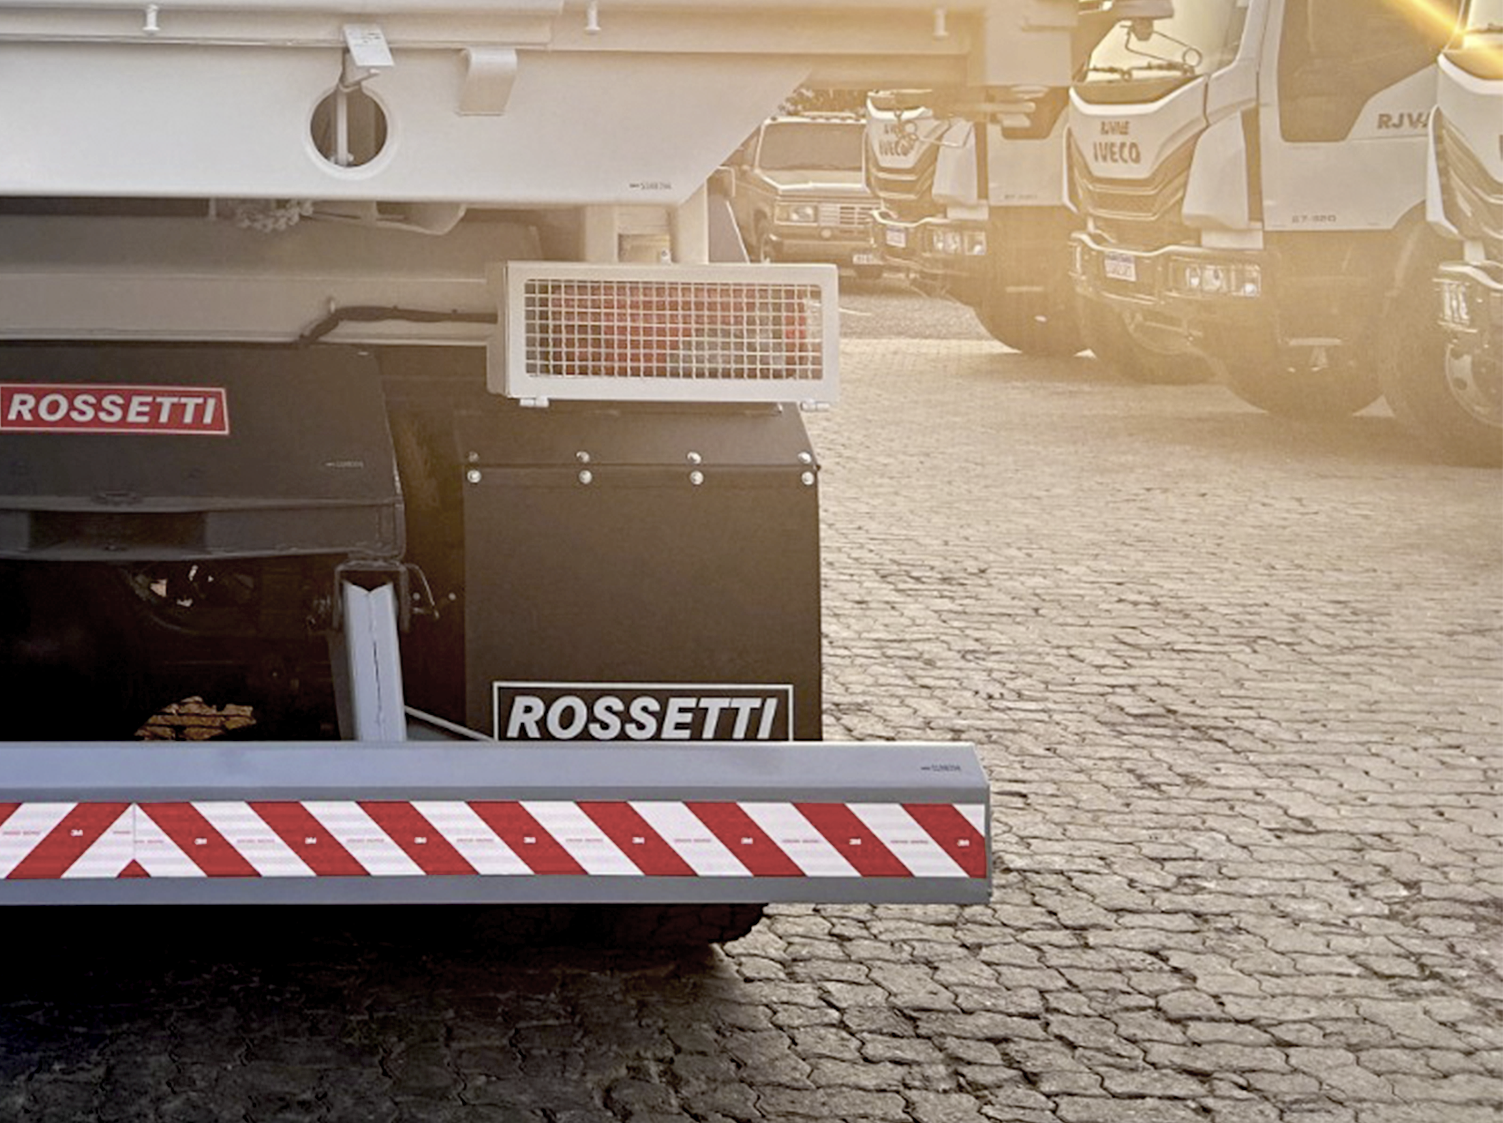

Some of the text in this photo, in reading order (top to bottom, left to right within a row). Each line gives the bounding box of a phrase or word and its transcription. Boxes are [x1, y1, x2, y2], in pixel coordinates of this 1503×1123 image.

[1093, 141, 1141, 164] IVECO
[7, 393, 217, 424] ROSSETTI
[506, 695, 778, 740] ROSSETTI
